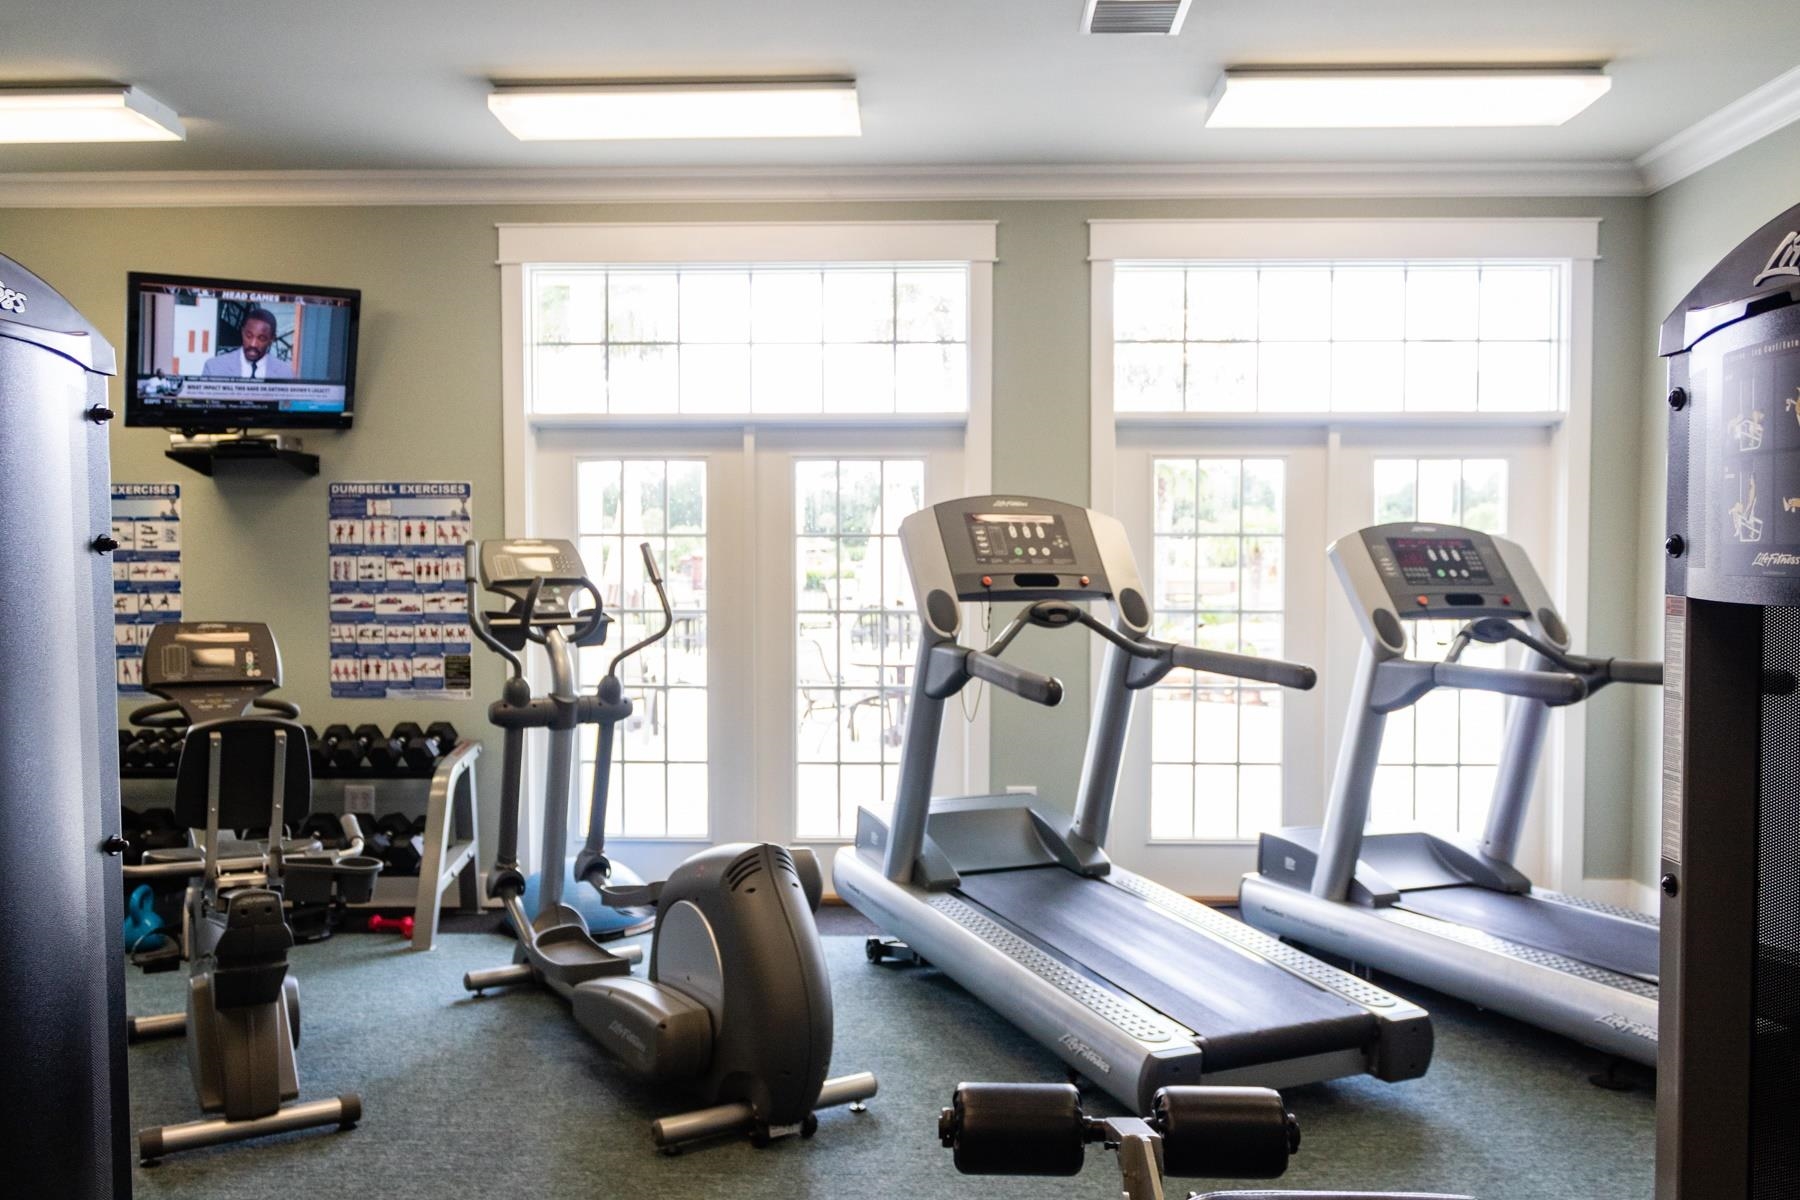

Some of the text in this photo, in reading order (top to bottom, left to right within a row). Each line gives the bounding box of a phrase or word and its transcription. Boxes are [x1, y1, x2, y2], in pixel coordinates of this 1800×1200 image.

[222, 290, 248, 300] HEAD
[111, 485, 176, 495] EXERCISES
[331, 484, 466, 495] DUMBBELL EXERCISES
